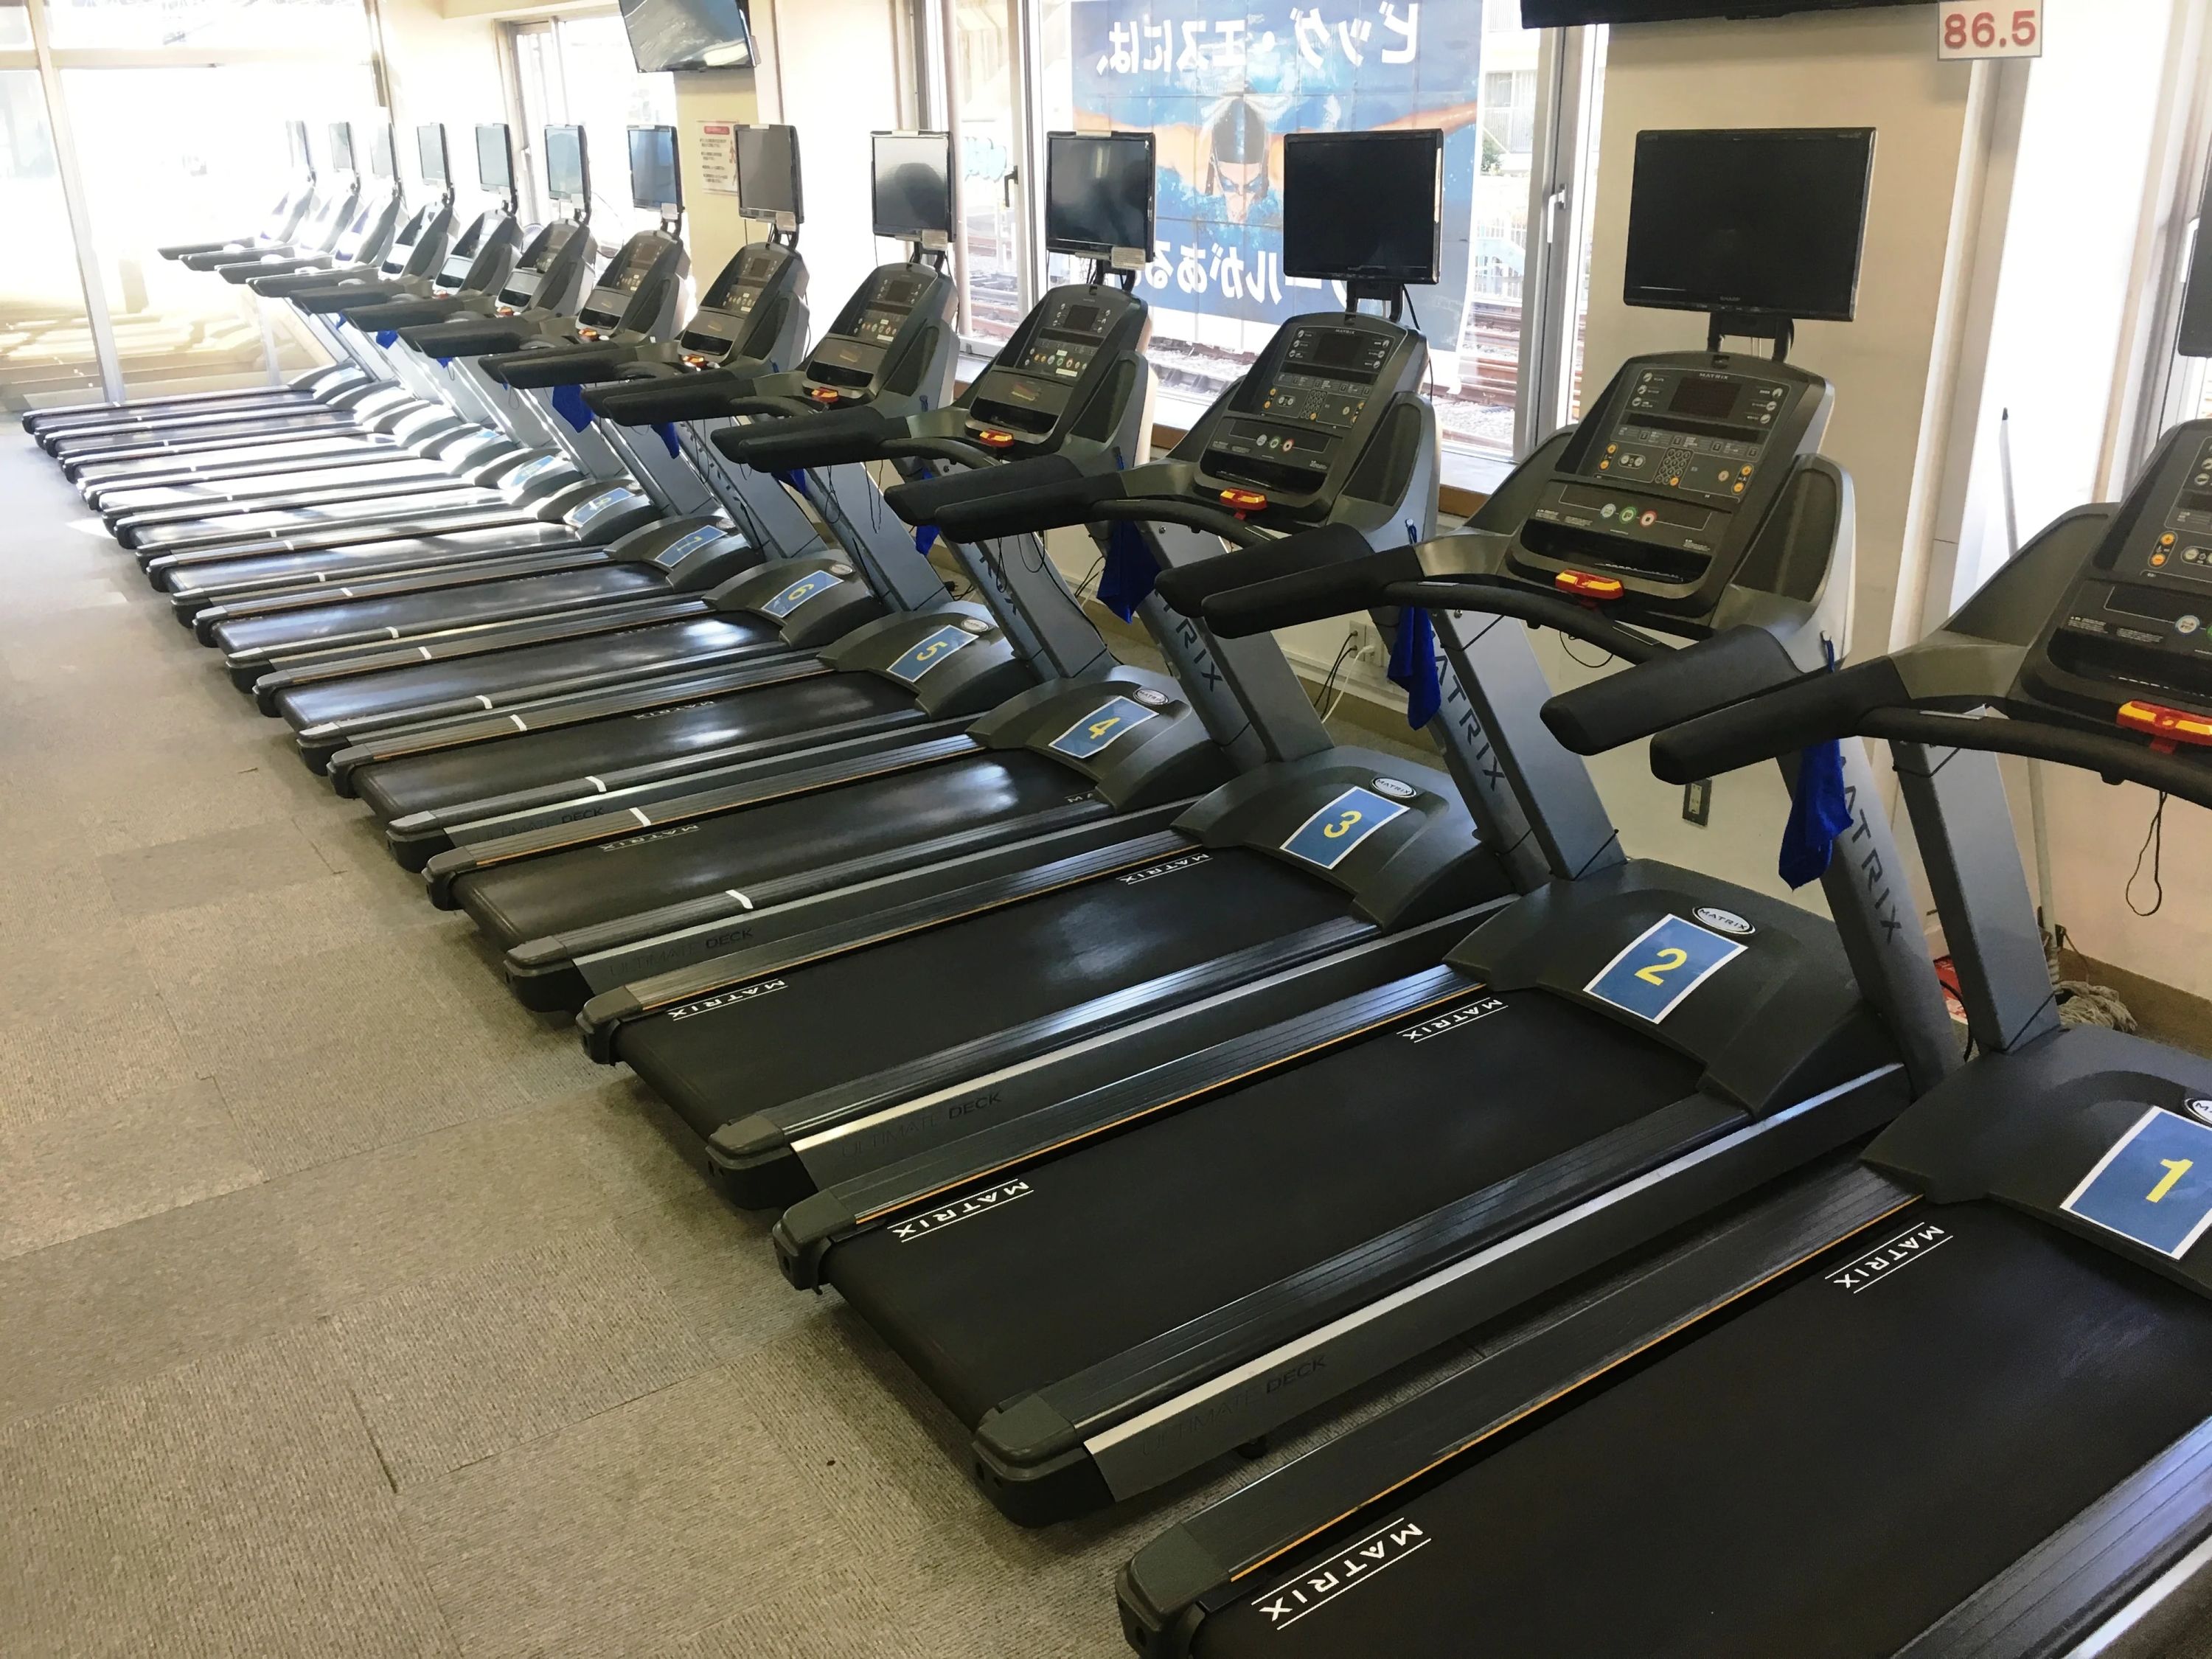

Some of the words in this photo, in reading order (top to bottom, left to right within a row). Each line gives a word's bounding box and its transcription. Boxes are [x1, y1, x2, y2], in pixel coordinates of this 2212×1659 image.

[1944, 10, 2036, 49] 86.5
[787, 583, 815, 601] 6
[917, 641, 948, 661] 5
[1088, 717, 1121, 740] 4
[1431, 630, 1506, 791] ATRIX
[1377, 779, 1411, 795] MATRIX
[1324, 810, 1363, 838] 3
[1119, 853, 1209, 883] MATRIX
[1840, 756, 1902, 944] ATRIX
[706, 928, 754, 948] DECK
[1698, 907, 1749, 931] MATRIX
[1635, 947, 1688, 987] 2
[668, 979, 786, 1018] MATRIX
[1402, 999, 1503, 1040] MATRIX
[949, 1091, 1002, 1120] DECK
[2146, 1158, 2194, 1203] 1
[892, 1182, 1030, 1238] MATRIX
[1833, 1225, 1945, 1289] MATRIX
[1266, 1355, 1327, 1394] DECK
[1259, 1523, 1424, 1622] MATRIX
